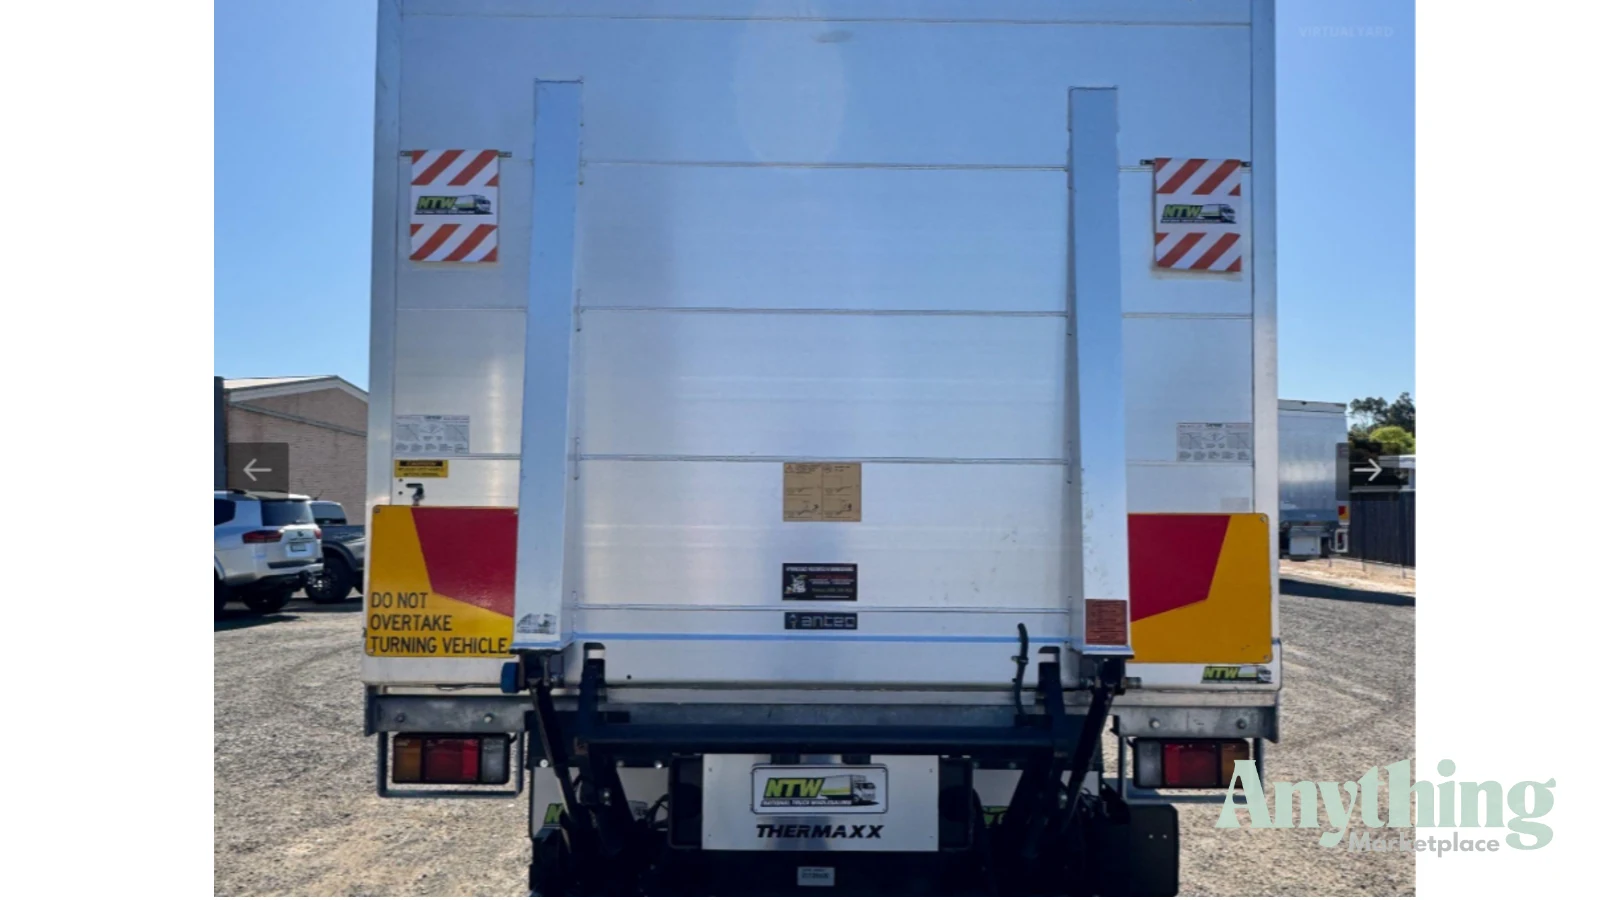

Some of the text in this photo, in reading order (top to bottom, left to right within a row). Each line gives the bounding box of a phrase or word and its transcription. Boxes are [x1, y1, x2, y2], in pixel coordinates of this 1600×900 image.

[416, 196, 457, 210] NTW
[1162, 204, 1202, 217] NTW
[371, 592, 428, 609] DO NOT
[370, 614, 453, 631] OVERTAKE
[370, 636, 508, 654] TURNING VEHICLE
[1203, 667, 1239, 680] NTW
[764, 778, 823, 797] NTW
[756, 824, 884, 839] THERMAXX
